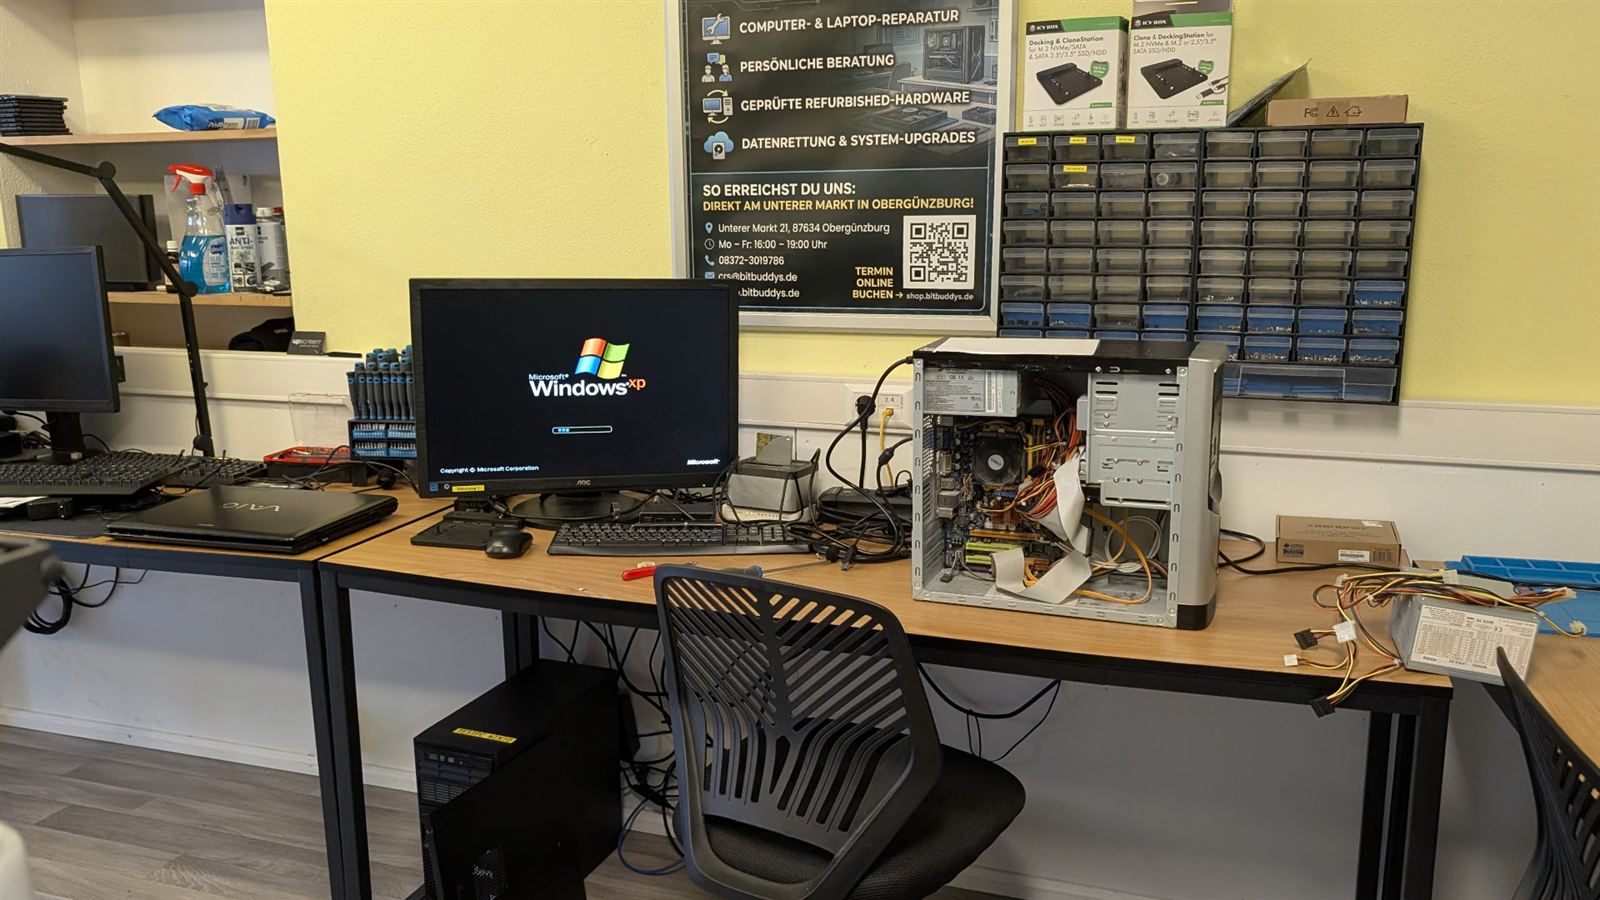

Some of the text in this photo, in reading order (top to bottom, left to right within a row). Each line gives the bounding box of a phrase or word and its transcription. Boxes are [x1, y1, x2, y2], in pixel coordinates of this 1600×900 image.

[740, 10, 960, 34] COMPUTER- & LAPTOP-REPARATUR
[740, 54, 894, 72] PERSÖNLICHE BERATUNG
[740, 91, 970, 112] GEPRÜFTE REFURBISHED-HARDWARE
[742, 131, 976, 150] DATENRETTUNG & SYSTEM-UPGRADES
[703, 182, 856, 197] SO ERREICHST DU UNS:
[703, 196, 974, 212] DIREKT AM UNTERER MARKT IN OBERGÜNZBURG!
[718, 222, 890, 236] Unterer Markt 21, 87634 Obergünzburg
[718, 240, 732, 250] Mo
[742, 240, 752, 250] Fr:
[754, 240, 776, 250] 16:00
[787, 240, 809, 250] 19:00
[811, 240, 828, 250] Uhr
[718, 255, 784, 266] 08372-3019786
[855, 266, 894, 276] TERMIN
[718, 272, 798, 284] crs@bitbuddys.de
[856, 278, 894, 288] ONLINE
[738, 288, 800, 300] .bitbuddys.de
[852, 290, 894, 300] BUCHEN
[906, 292, 974, 302] shop.bitbuddys.de
[529, 380, 628, 396] Windows
[222, 502, 280, 512] VAIO
